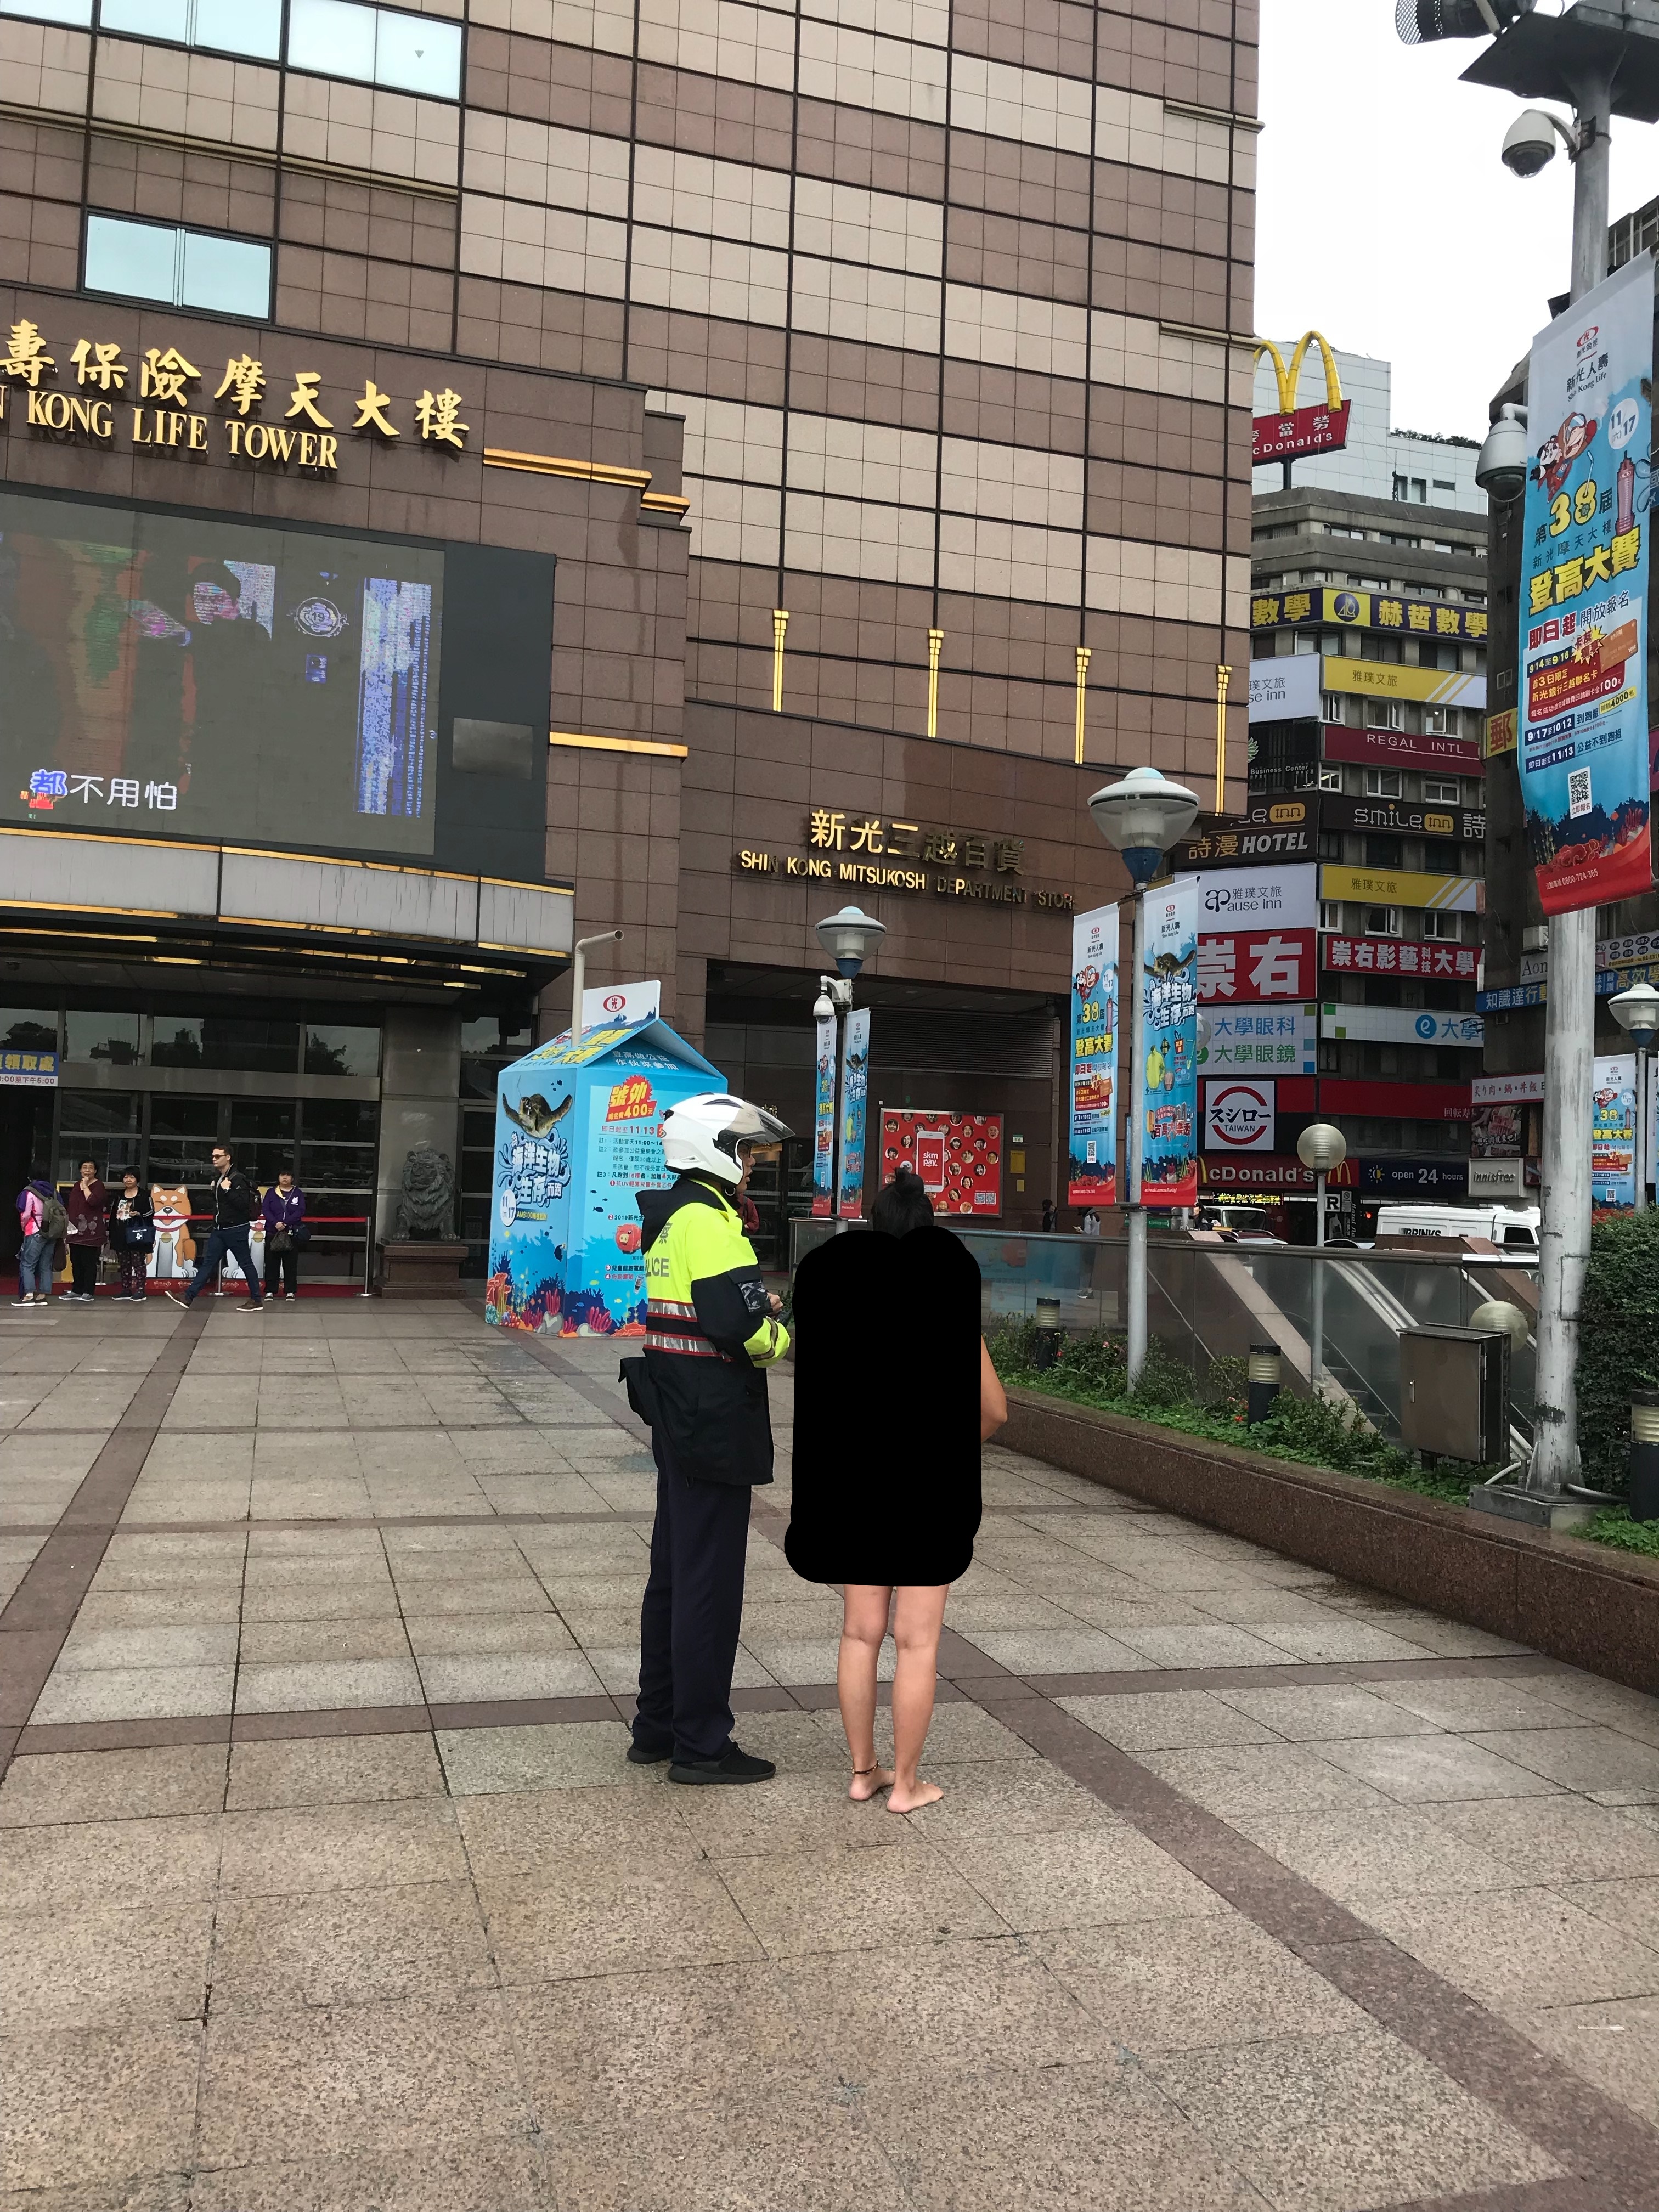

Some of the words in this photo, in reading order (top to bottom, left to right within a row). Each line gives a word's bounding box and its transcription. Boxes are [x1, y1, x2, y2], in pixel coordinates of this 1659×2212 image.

[1567, 352, 1609, 393] 新光人壽
[1578, 380, 1594, 393] Kong
[1595, 371, 1607, 383] Life
[0, 319, 470, 450] 壽保險摩天大樓
[27, 389, 113, 438] KONG
[132, 407, 208, 451] LIFE
[225, 420, 338, 469] TOWER
[1252, 592, 1312, 625] 數學
[1528, 611, 1577, 651] 即日起
[1580, 590, 1629, 628] 開放報名
[1352, 670, 1398, 687] 雅璞文旅
[1267, 690, 1286, 701] inn
[1367, 733, 1418, 749] REGAL
[1431, 741, 1464, 754] INTL
[1250, 767, 1282, 775] Business
[29, 768, 177, 811] 都不用怕
[810, 809, 1026, 876] 新光三越百貨
[1188, 834, 1239, 860] 詩漫
[1242, 832, 1308, 854] HOTEL
[741, 849, 778, 873] SHIN
[787, 857, 832, 878] KONG
[839, 863, 930, 890] MITSUKOSHI
[936, 875, 1031, 904] DEPARTMENT
[1232, 885, 1282, 900] 雅璞文旅
[1351, 878, 1398, 894] 雅璞文旅
[1263, 898, 1282, 910] inn
[1197, 936, 1302, 998] 崇右
[1214, 1016, 1296, 1037] 大學眼科
[1441, 1018, 1485, 1041] 大學
[0, 1054, 54, 1073] 領取處
[1214, 1043, 1296, 1064] 大學眼鏡
[609, 1081, 648, 1108] 號外
[1209, 1108, 1272, 1124] スシロー
[1224, 1125, 1255, 1133] TAIWAN
[923, 1150, 939, 1159] skm
[1392, 1170, 1414, 1180] open
[1418, 1168, 1438, 1184] 24
[1442, 1172, 1464, 1181] hours
[1473, 1169, 1516, 1185] innisfree
